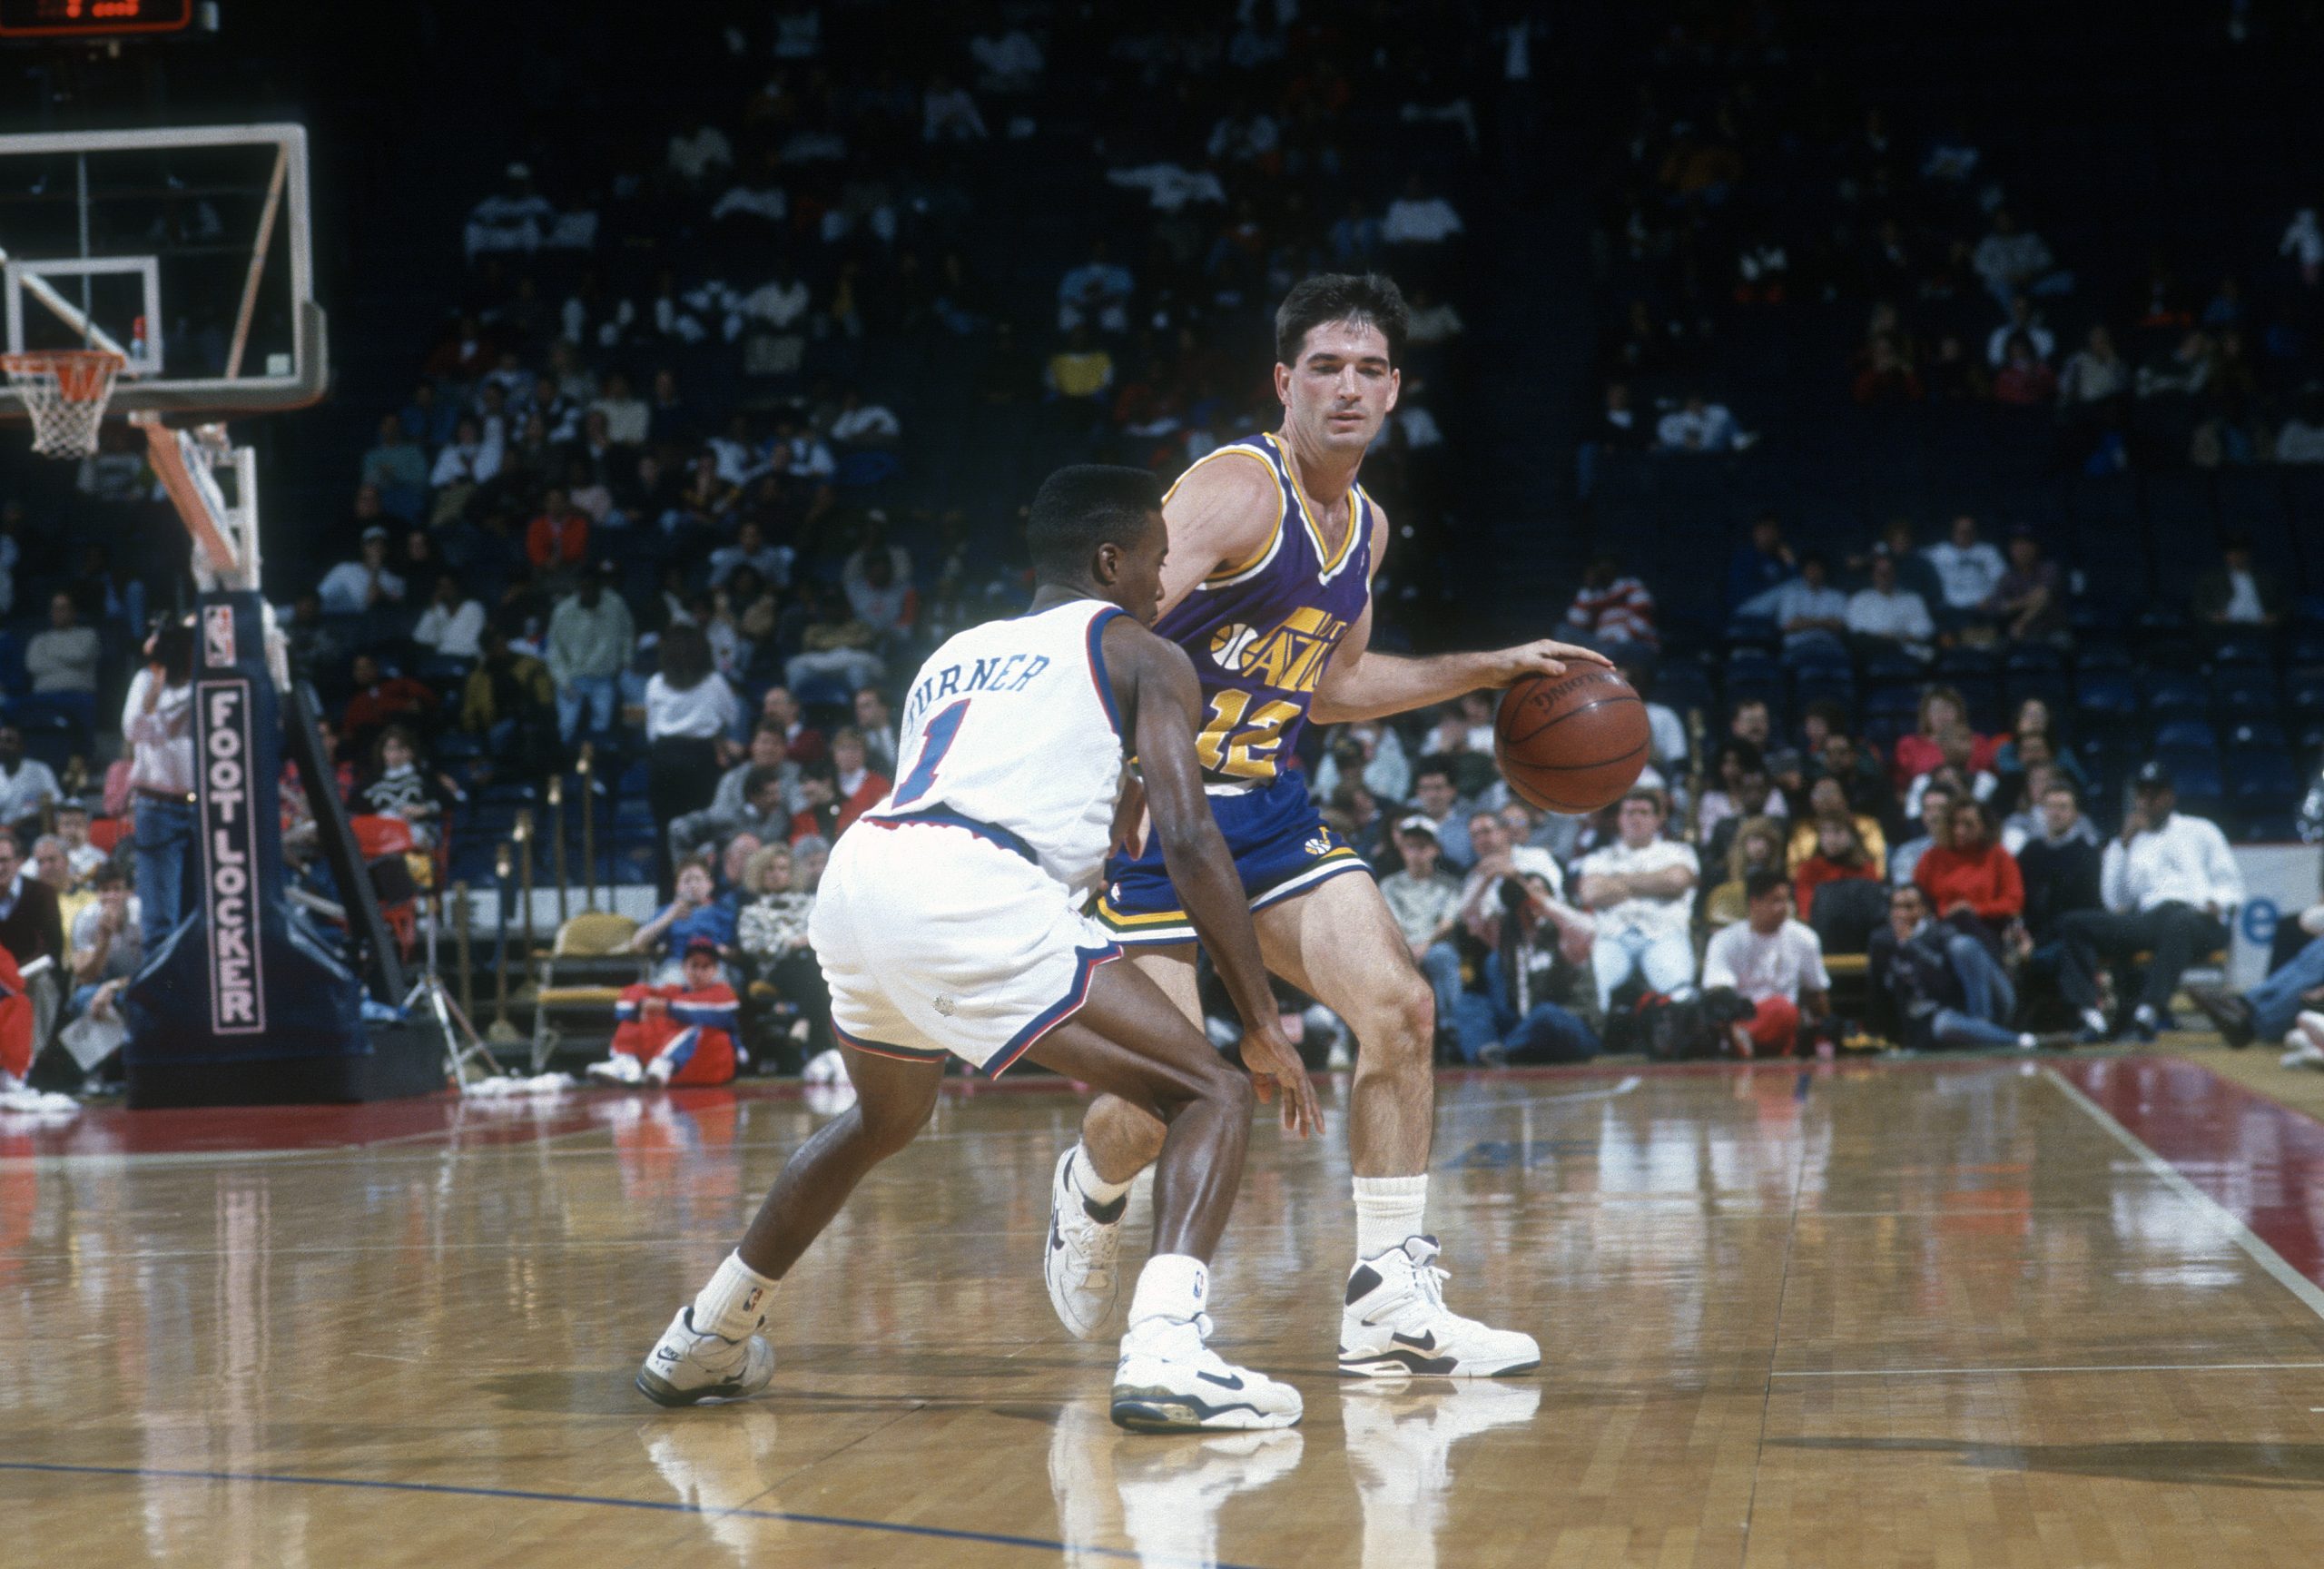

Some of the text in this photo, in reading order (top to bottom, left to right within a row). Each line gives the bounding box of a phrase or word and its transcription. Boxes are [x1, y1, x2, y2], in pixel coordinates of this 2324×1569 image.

[891, 696, 972, 811] 1
[1194, 687, 1303, 778] 12
[209, 691, 254, 1021] FOOT LOCKER
